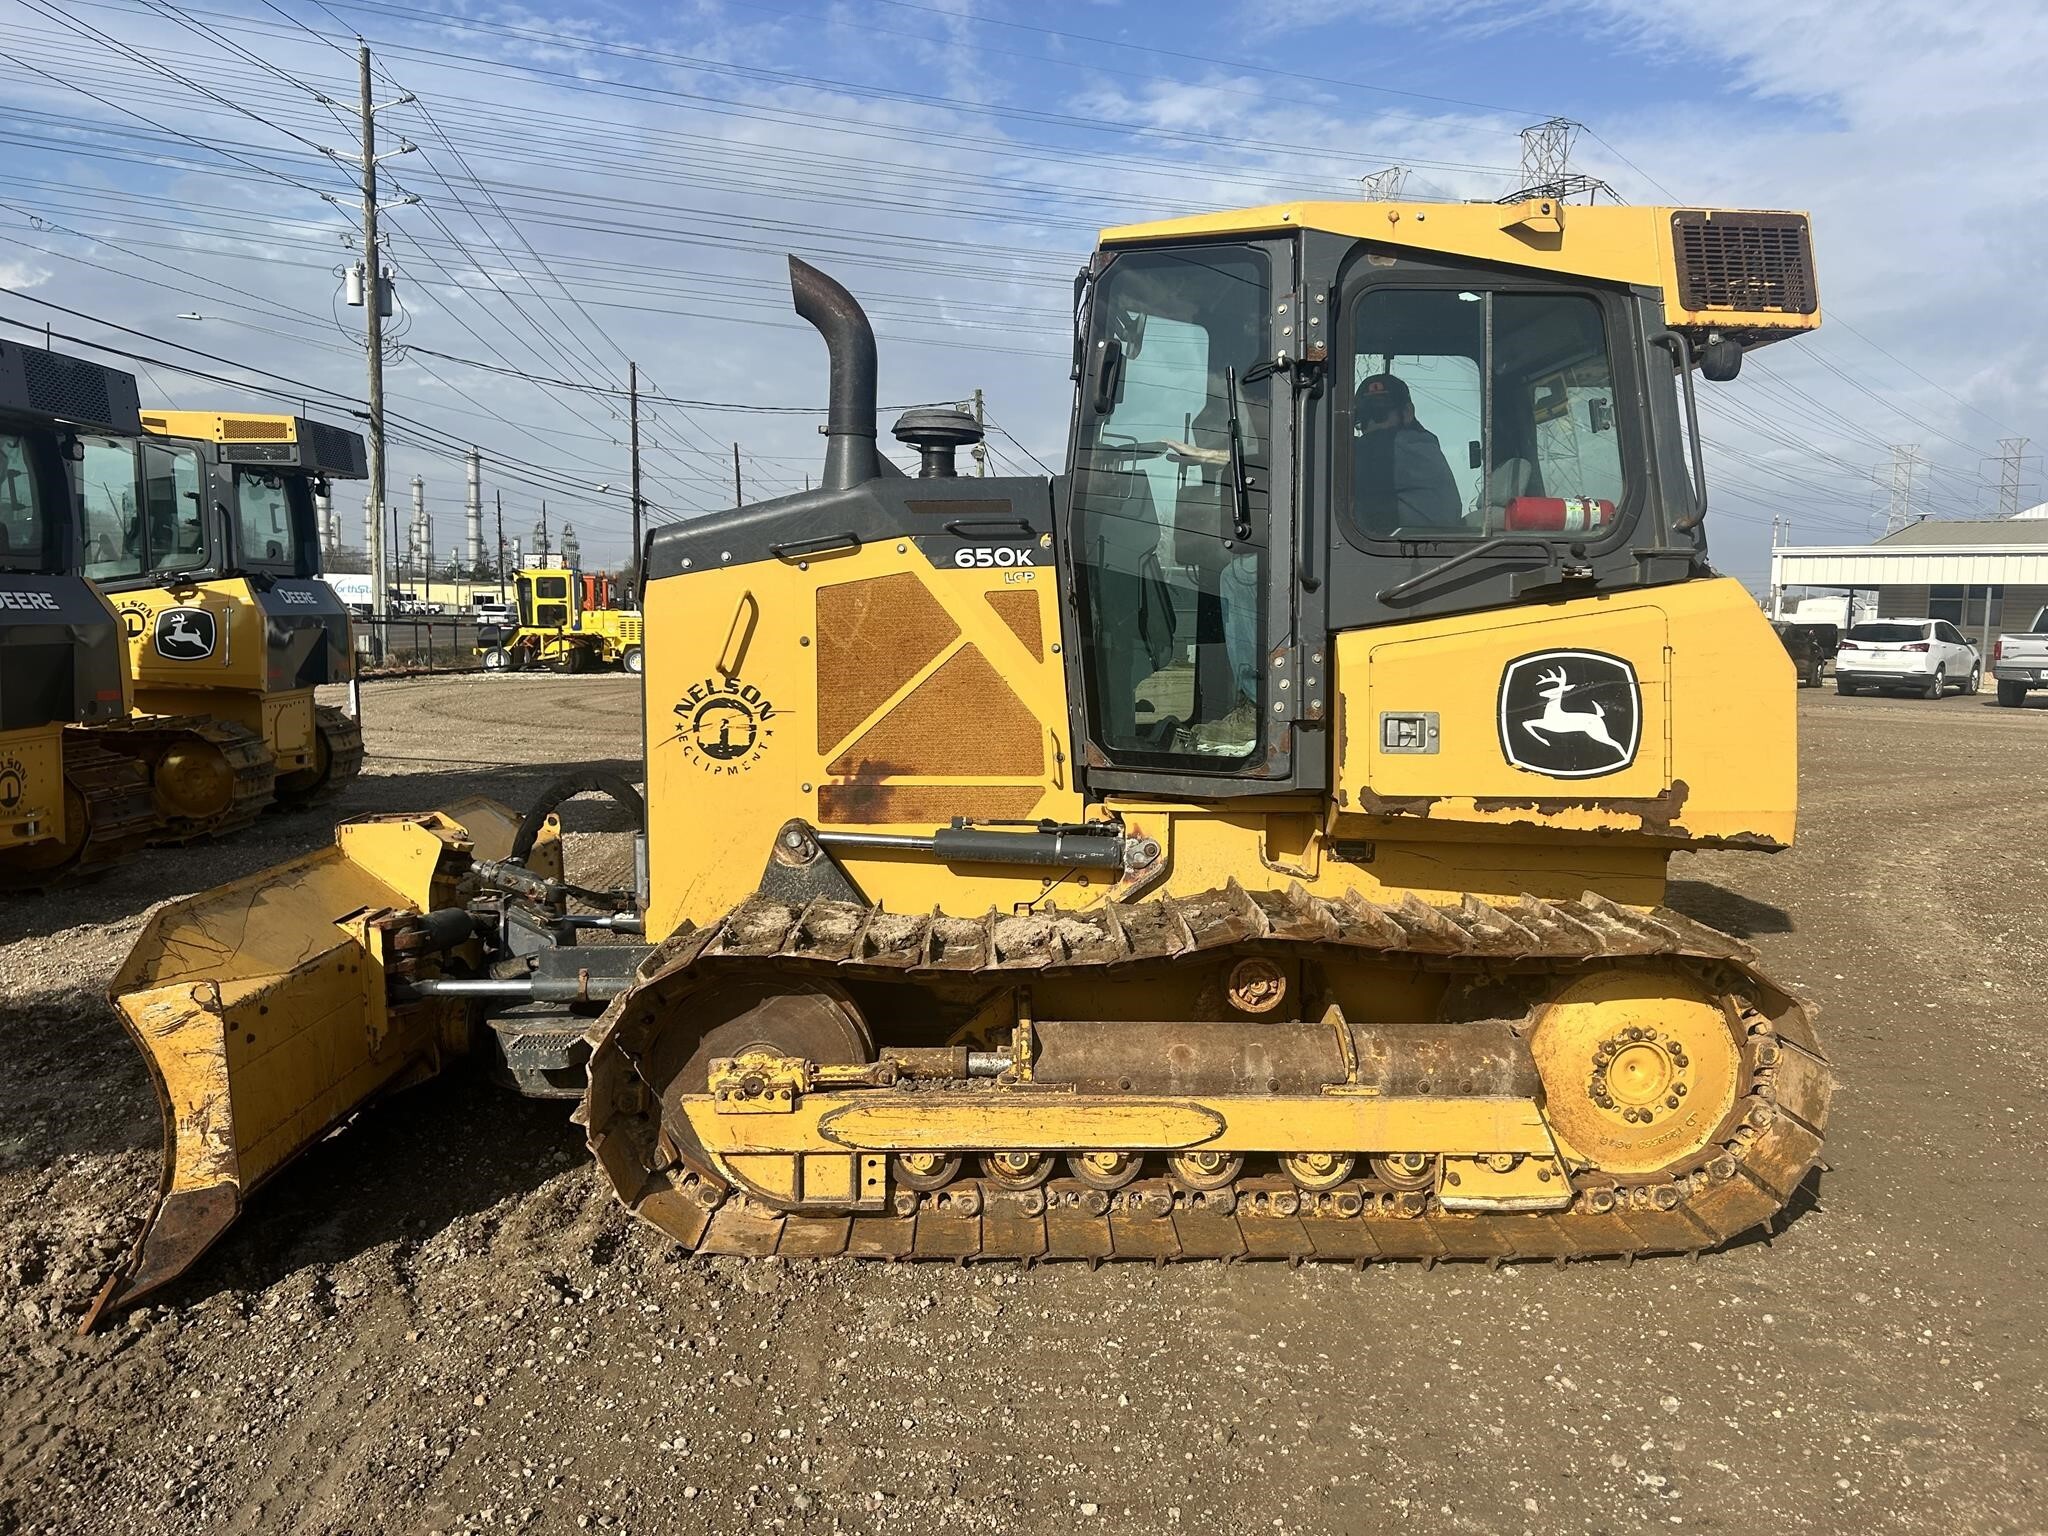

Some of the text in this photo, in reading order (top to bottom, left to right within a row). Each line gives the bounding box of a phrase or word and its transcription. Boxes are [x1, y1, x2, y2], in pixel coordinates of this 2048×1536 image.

[954, 547, 1035, 568] 650K
[277, 588, 318, 605] DEERE
[673, 678, 776, 722] NELSON
